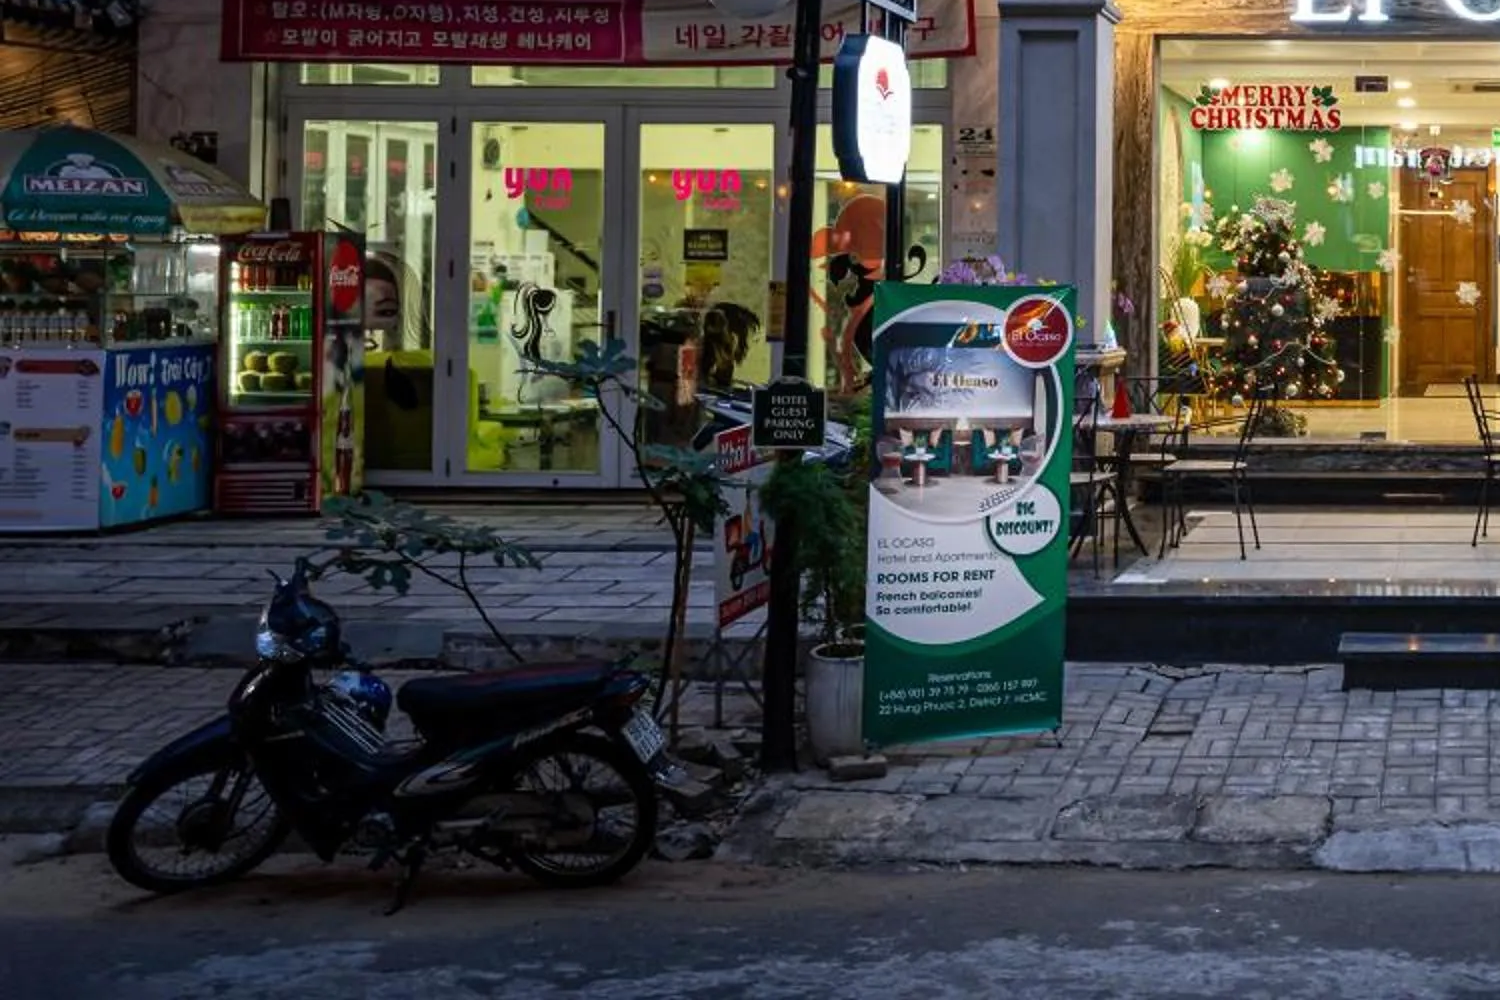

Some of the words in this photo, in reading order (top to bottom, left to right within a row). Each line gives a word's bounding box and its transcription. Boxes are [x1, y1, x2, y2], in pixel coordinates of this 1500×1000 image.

[1219, 85, 1310, 107] MERRY
[1190, 106, 1342, 131] CHRISTMAS
[959, 127, 993, 141] 24
[28, 177, 145, 194] MEIZAN
[504, 168, 573, 199] yun
[672, 168, 742, 200] yun
[771, 395, 808, 405] HOTEL
[771, 406, 808, 417] GUEST
[763, 418, 815, 430] PARKING
[773, 429, 805, 440] ONLY
[995, 519, 1054, 537] DISCOUNT!
[877, 538, 889, 549] EL
[892, 537, 936, 549] OCASO
[909, 552, 932, 563] and
[877, 571, 929, 585] ROOMS
[933, 570, 960, 582] FOR
[963, 569, 996, 581] RENT
[876, 590, 917, 603] French
[875, 605, 891, 617] So
